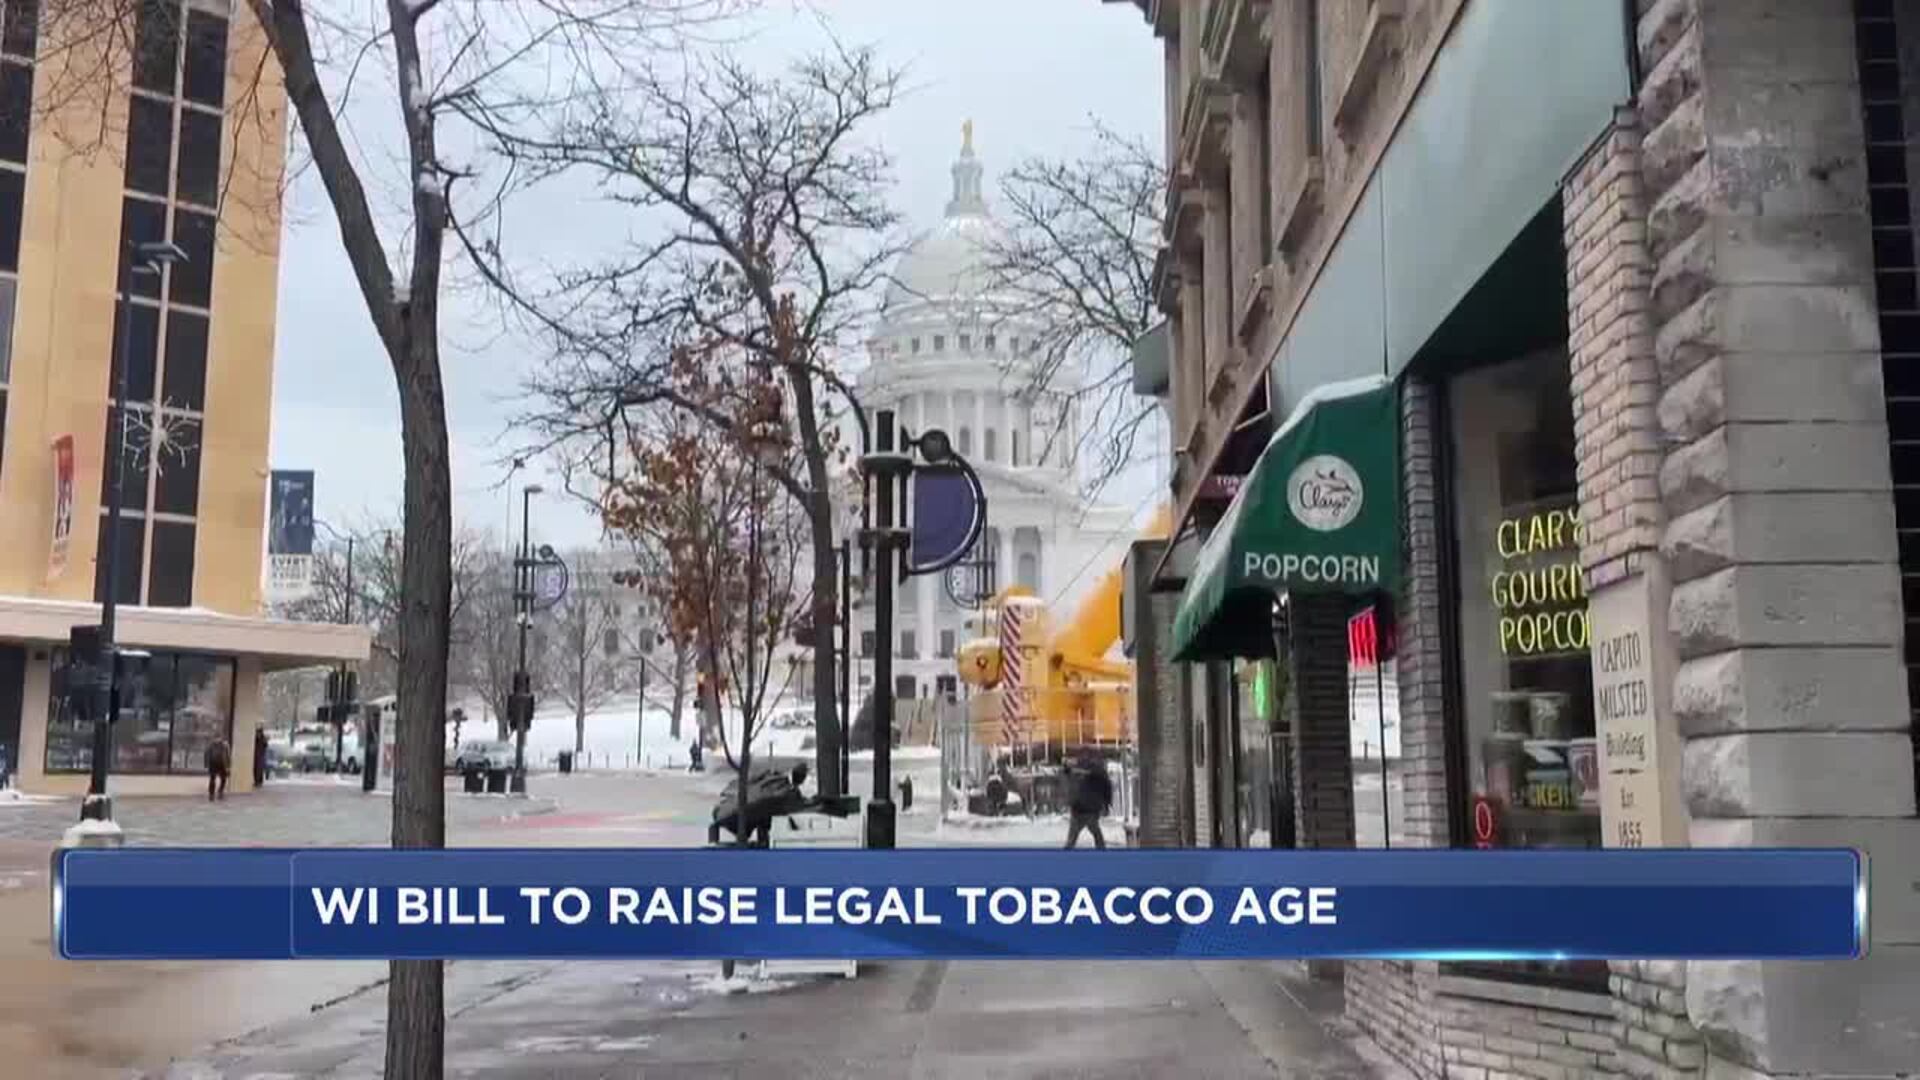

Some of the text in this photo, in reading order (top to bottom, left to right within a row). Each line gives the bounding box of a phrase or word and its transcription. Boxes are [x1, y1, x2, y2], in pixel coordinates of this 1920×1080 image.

[1244, 551, 1380, 582] POPCORN
[1500, 609, 1592, 653] POPCO
[1600, 631, 1641, 673] CAPUTO
[1599, 680, 1648, 720] MILSTED
[1606, 731, 1645, 762] Building
[1618, 820, 1642, 848] 1855
